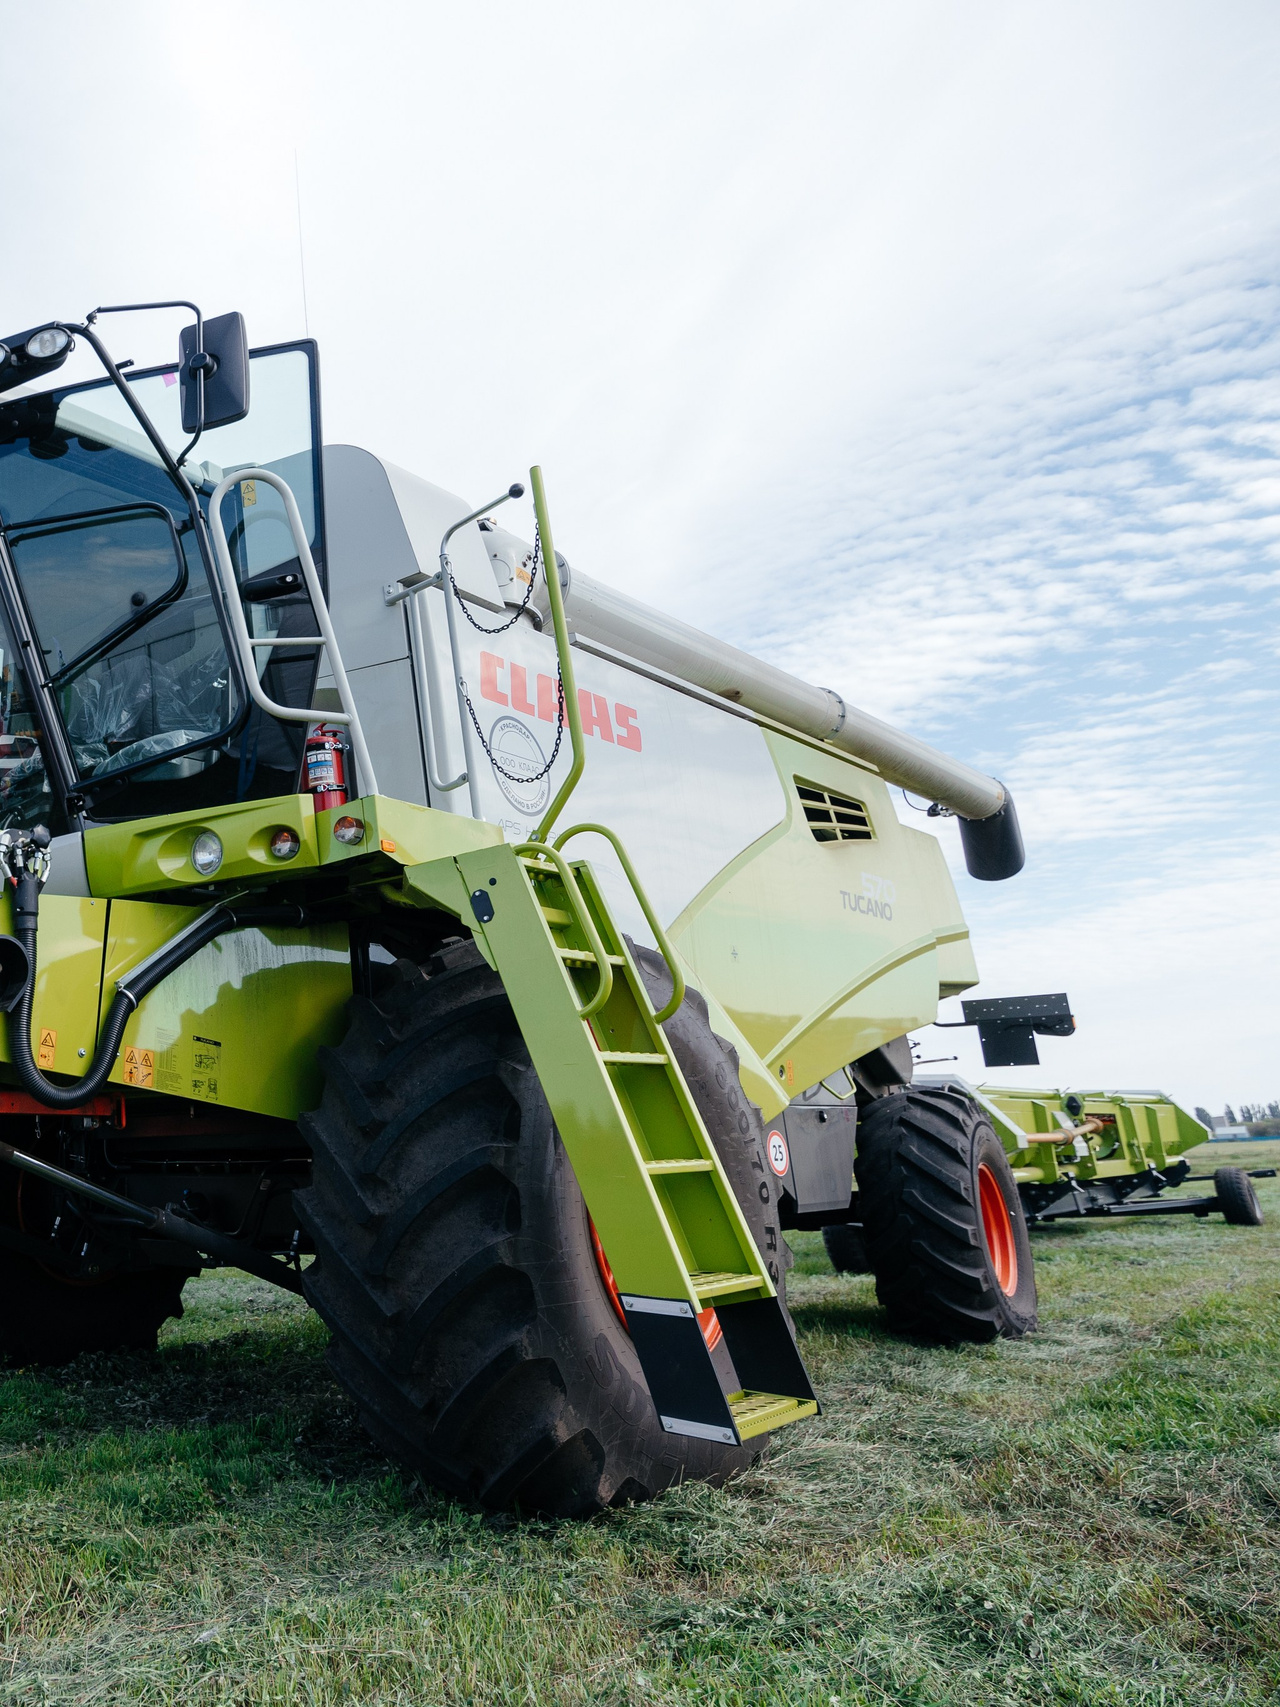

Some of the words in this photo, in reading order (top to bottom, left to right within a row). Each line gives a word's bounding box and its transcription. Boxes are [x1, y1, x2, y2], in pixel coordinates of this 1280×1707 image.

[480, 650, 642, 752] CLAAS
[499, 722, 531, 740] КРАСНОДАР
[500, 756, 516, 768] ООО
[501, 781, 526, 809] СДЕЛАНО
[530, 790, 546, 810] РОССИИ
[861, 871, 896, 905] 570
[839, 889, 893, 921] TUCANO
[772, 1144, 784, 1162] 25
